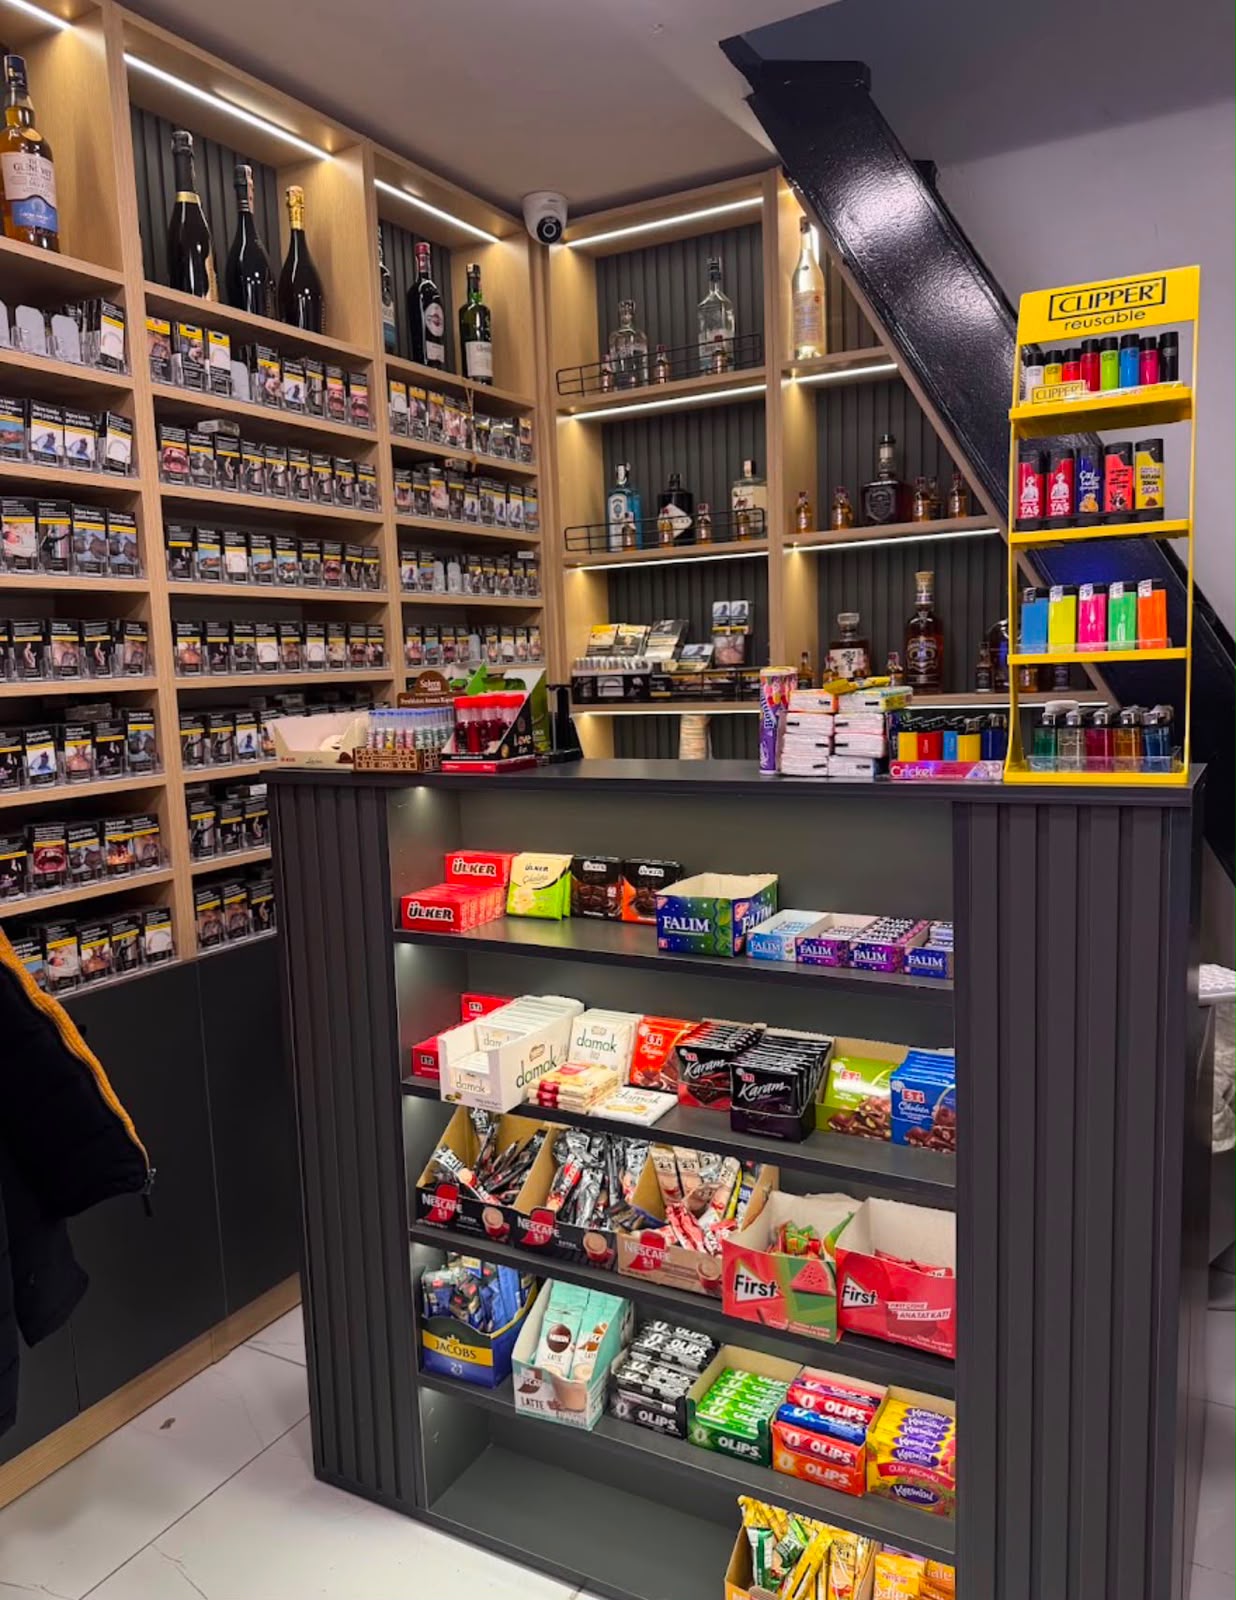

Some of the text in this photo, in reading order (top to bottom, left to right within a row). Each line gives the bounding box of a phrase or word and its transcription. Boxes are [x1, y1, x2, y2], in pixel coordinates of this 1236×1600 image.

[1059, 283, 1154, 314] CLIPPER
[1064, 309, 1146, 331] reusable
[890, 764, 934, 778] Cricket
[453, 858, 496, 875] ÜLKER
[407, 902, 453, 921] ÜLKER
[663, 916, 709, 932] FALIM
[750, 940, 781, 951] FALIM
[800, 944, 832, 956] FALIM
[853, 949, 887, 961] FALIM
[908, 955, 944, 967] FALIM
[576, 1028, 618, 1053] damak
[516, 1045, 558, 1089] damak
[684, 1059, 729, 1079] Karam
[456, 1074, 486, 1093] damak
[738, 1081, 791, 1102] Karam
[735, 1275, 777, 1297] First
[841, 1285, 877, 1304] First
[434, 1340, 477, 1359] JACOBS
[521, 1397, 545, 1410] LATTE
